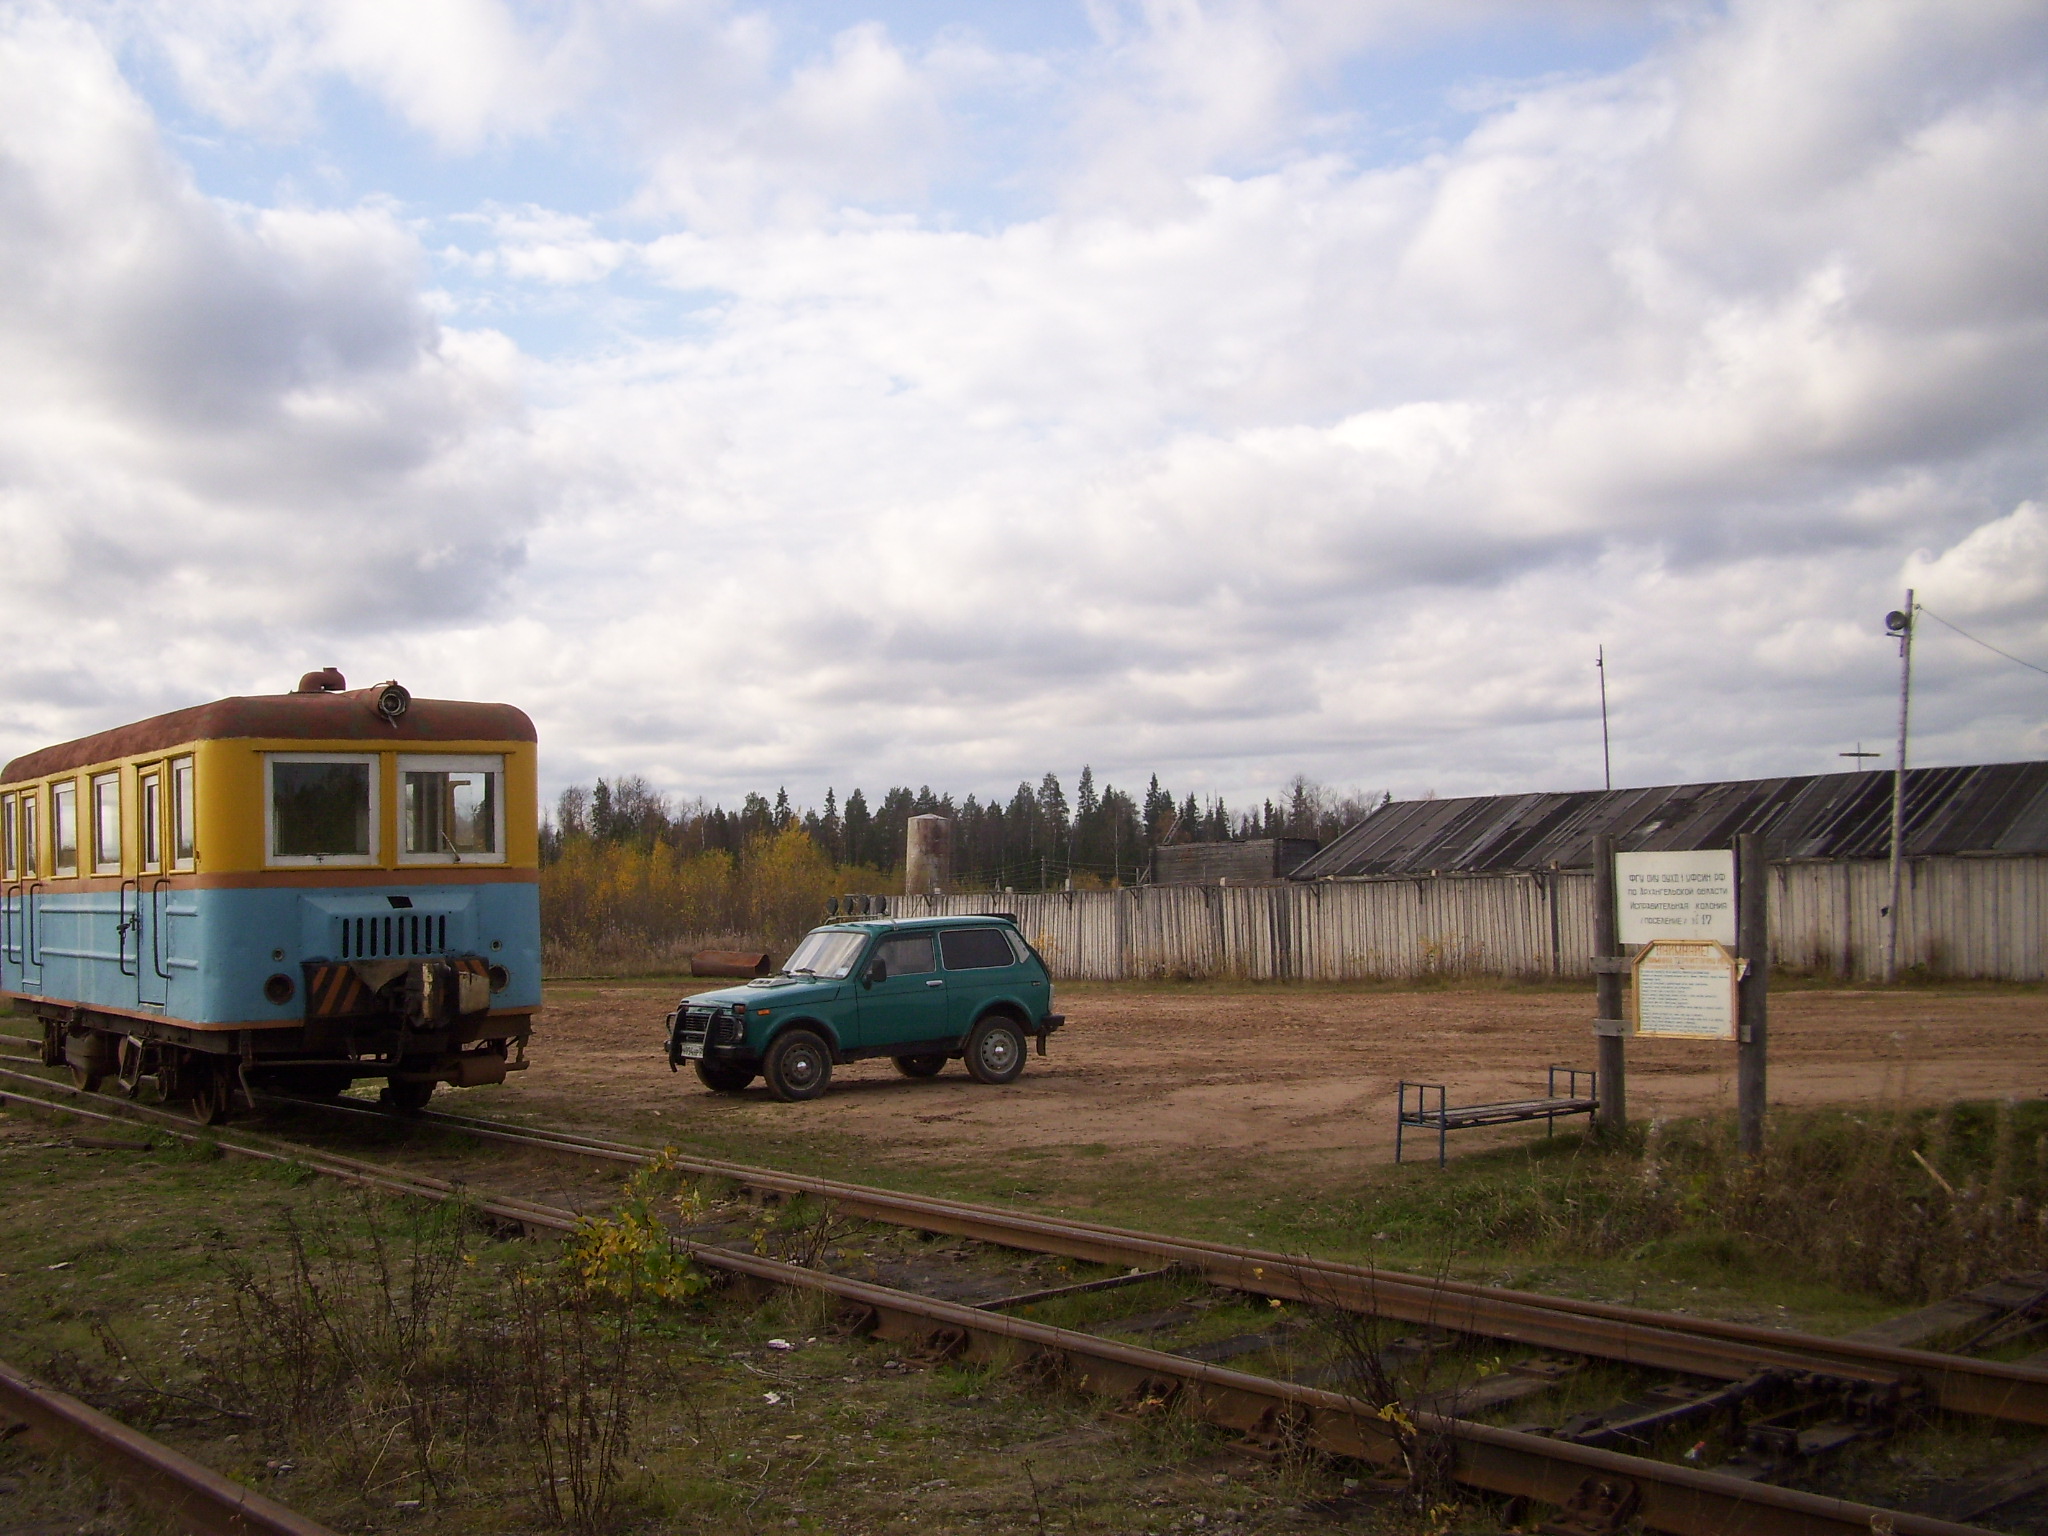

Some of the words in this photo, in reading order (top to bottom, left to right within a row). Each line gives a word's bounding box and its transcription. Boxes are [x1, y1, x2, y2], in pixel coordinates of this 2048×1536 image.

[1629, 874, 1644, 882] ФГУ
[1686, 873, 1711, 882] УФСИН
[1714, 873, 1726, 881] РФ
